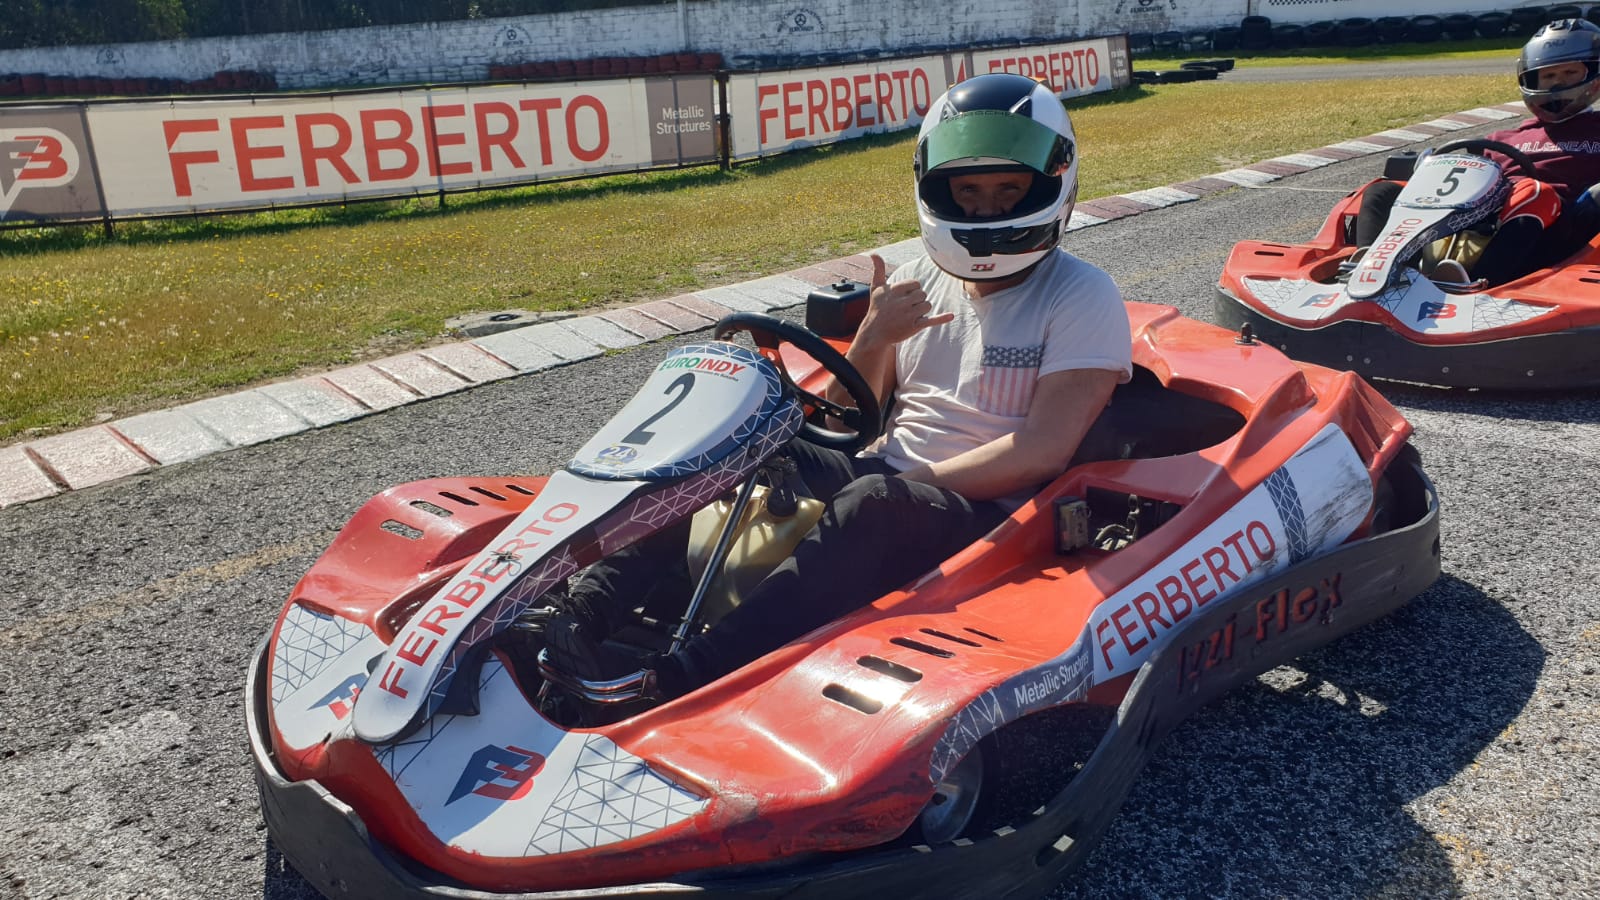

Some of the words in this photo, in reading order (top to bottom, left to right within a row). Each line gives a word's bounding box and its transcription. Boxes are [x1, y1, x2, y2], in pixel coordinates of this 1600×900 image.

[988, 48, 1099, 94] BERTO
[656, 120, 712, 135] Structures
[662, 106, 705, 120] Metallic
[758, 67, 931, 145] FERBERTO
[162, 94, 610, 198] FERBERTO
[1436, 167, 1467, 197] 5
[1359, 218, 1423, 283] FERBERTO
[659, 357, 746, 376] EUROINDY
[621, 372, 695, 446] 2
[378, 502, 580, 699] FERBERTO
[1095, 520, 1276, 673] FERBERTO
[1014, 671, 1060, 708] Metallic
